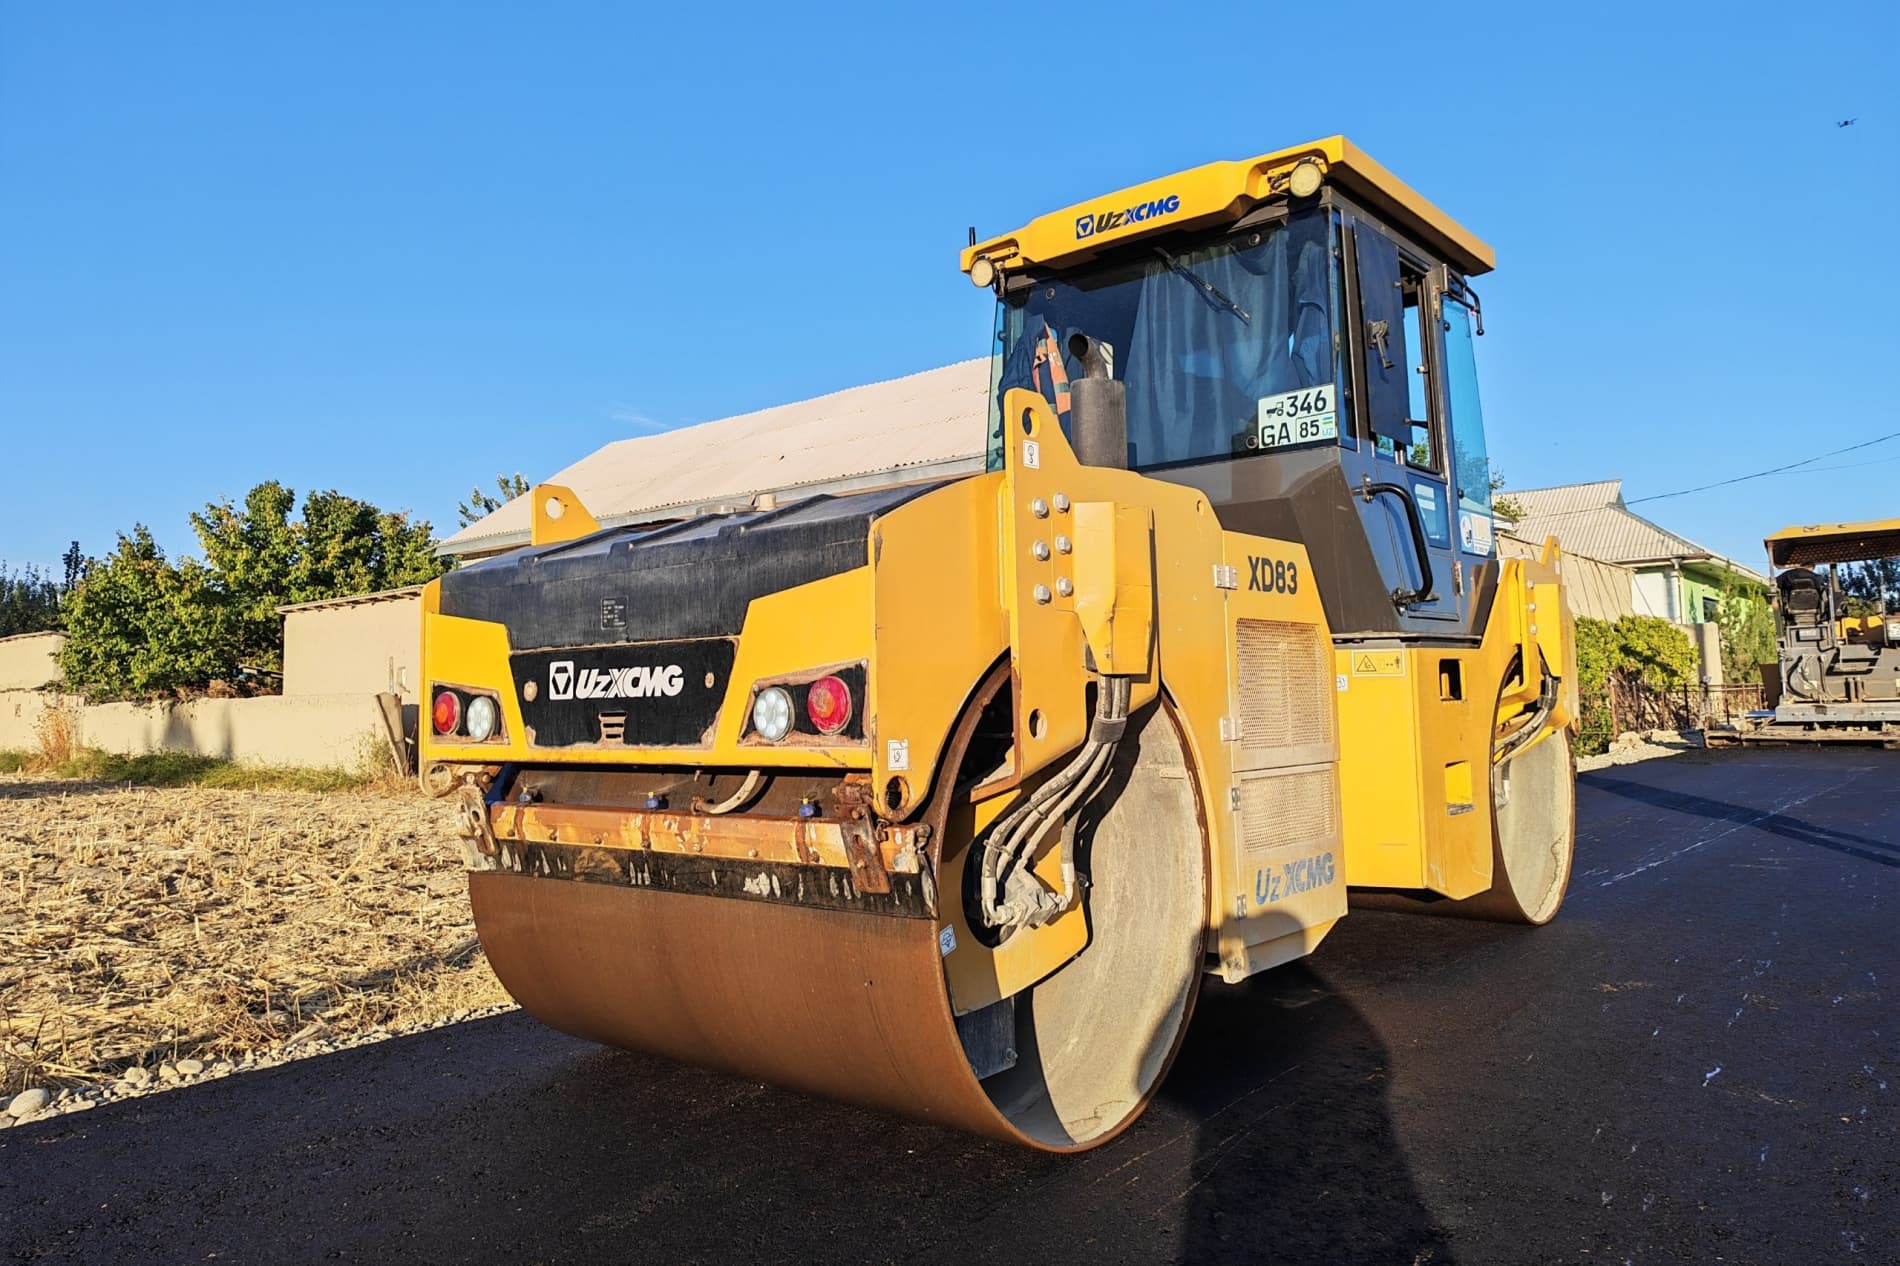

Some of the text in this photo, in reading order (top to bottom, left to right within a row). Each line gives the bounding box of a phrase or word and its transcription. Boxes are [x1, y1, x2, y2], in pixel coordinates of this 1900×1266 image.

[1096, 195, 1180, 233] UzXCMG
[1286, 390, 1327, 417] 346
[1261, 419, 1320, 447] GA 85
[1248, 555, 1298, 595] XD83
[576, 664, 684, 699] UzXCMG
